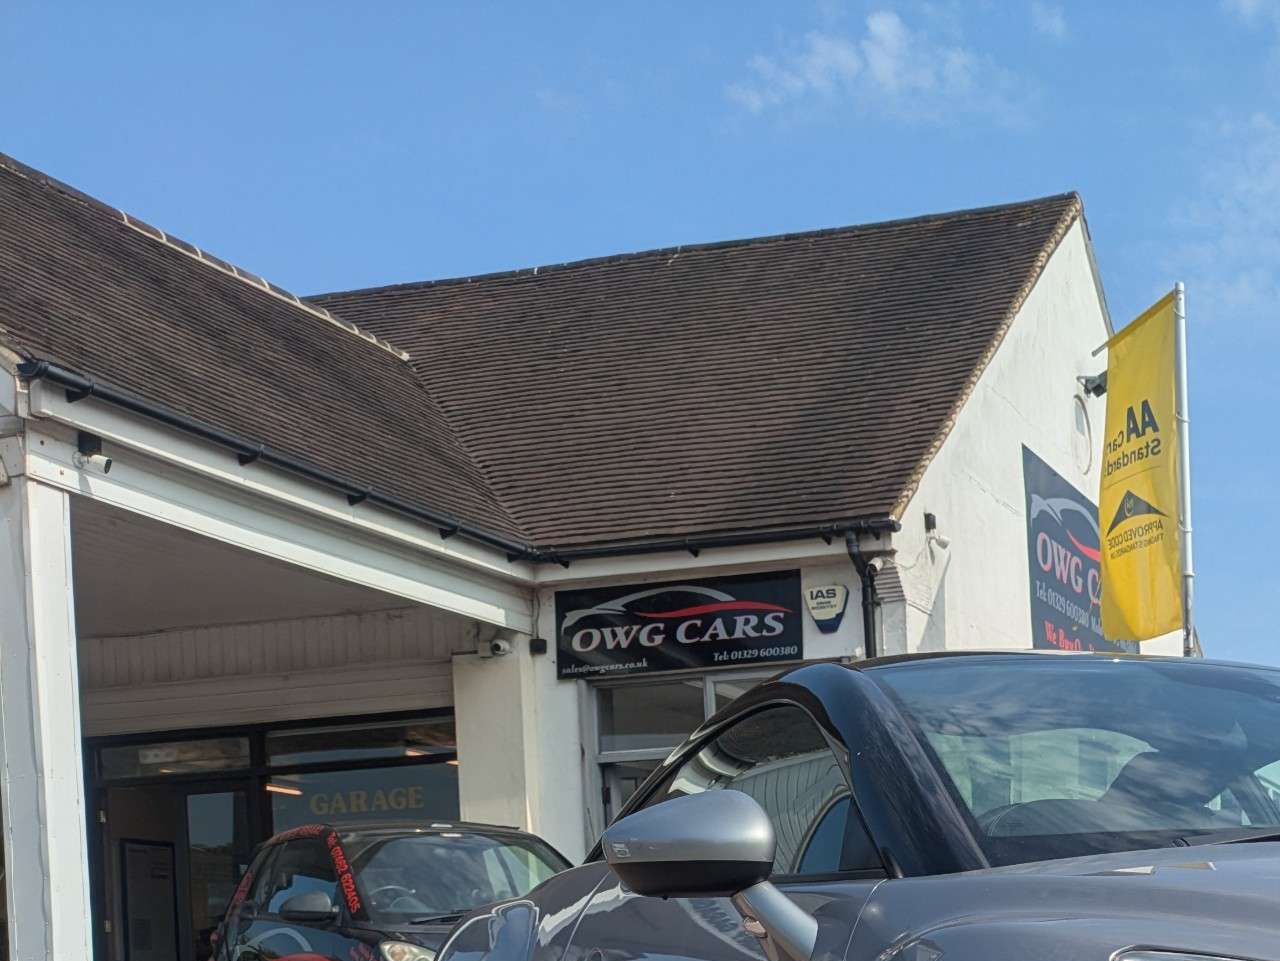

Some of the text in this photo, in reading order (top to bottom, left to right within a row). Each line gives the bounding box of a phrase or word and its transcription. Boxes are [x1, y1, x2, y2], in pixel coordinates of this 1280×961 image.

[1036, 531, 1083, 593] OWG
[810, 588, 837, 601] IAS
[571, 612, 784, 652] OWG CARS
[713, 645, 798, 662] Tel: 01329 600380
[309, 785, 425, 816] GARAGE
